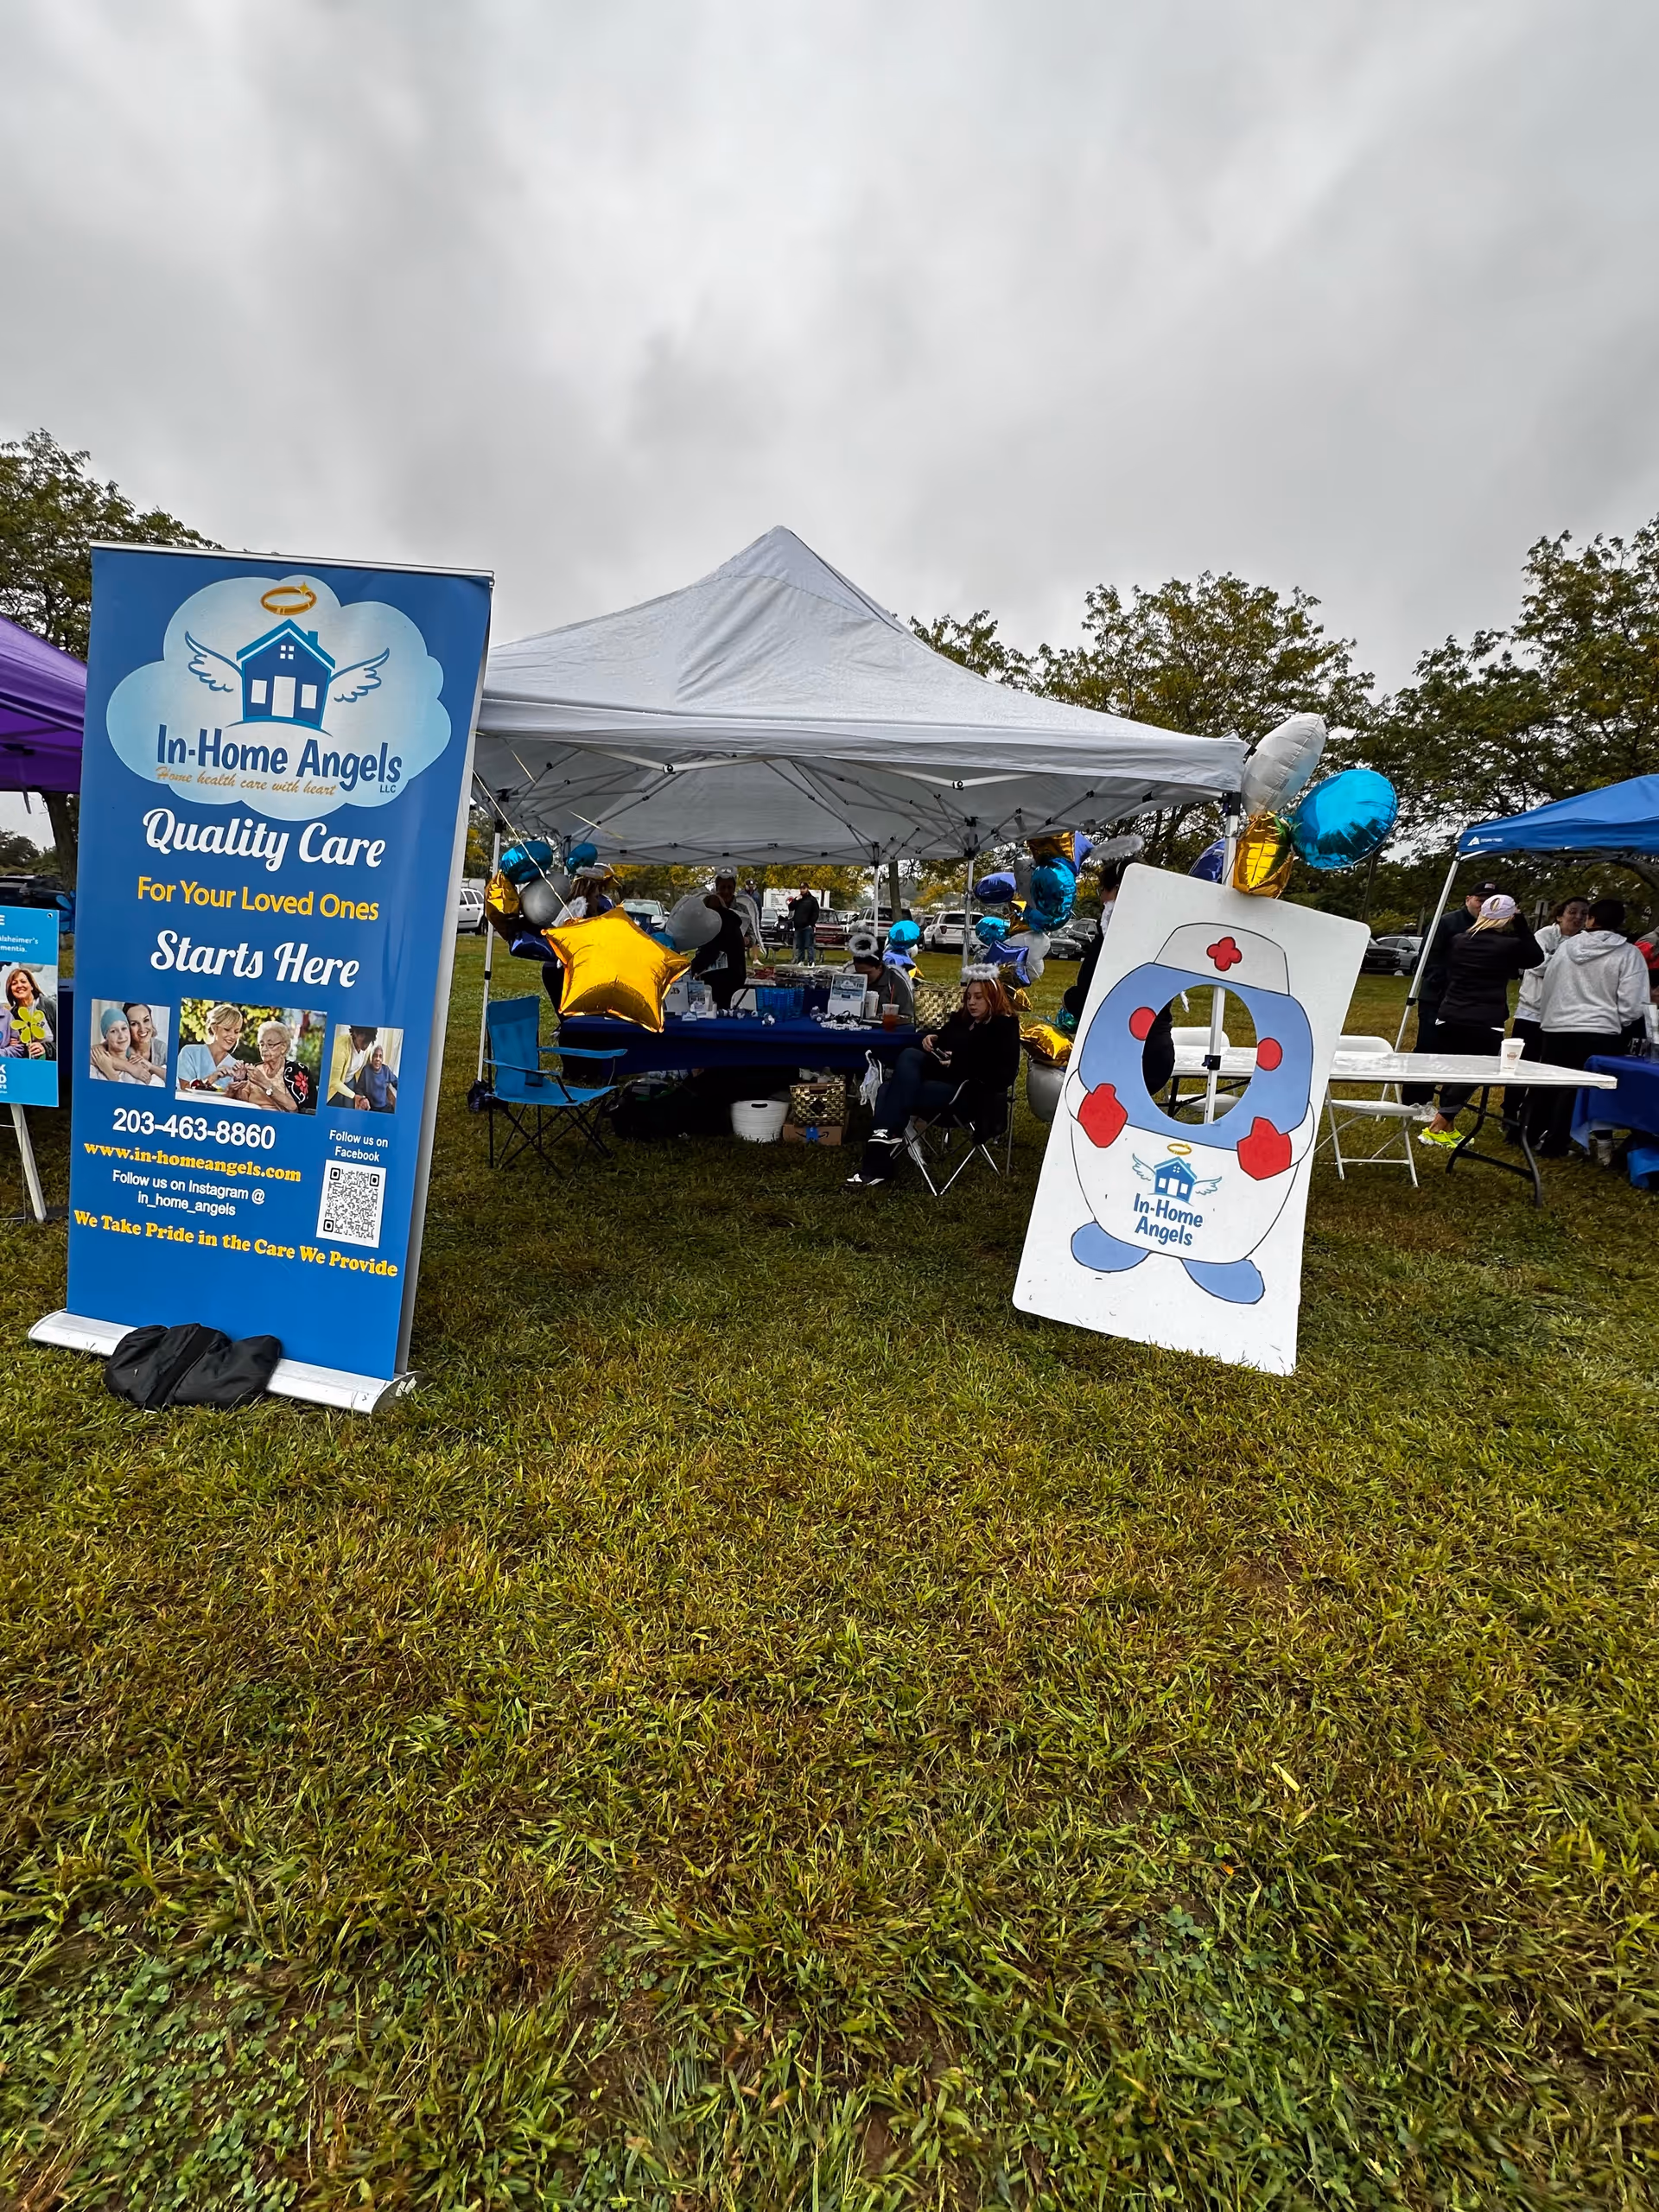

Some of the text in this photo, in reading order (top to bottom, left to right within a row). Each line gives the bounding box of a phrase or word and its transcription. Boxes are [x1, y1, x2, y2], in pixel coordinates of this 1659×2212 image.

[157, 723, 402, 791] In-Home Angels
[156, 766, 336, 796] Home health care with heart
[379, 785, 397, 793] LLC
[143, 808, 385, 872] Quality Care
[137, 876, 379, 921] For Your Loved Ones
[0, 935, 39, 944] lzheimer's
[150, 930, 359, 988] Starts Here
[112, 1108, 276, 1150] 203-463-8860
[328, 1129, 389, 1148] Follow us on
[84, 1143, 302, 1182] www.in-homeangels.com
[334, 1146, 380, 1162] Facebook
[112, 1169, 265, 1205] Follow us on Instagram @
[137, 1191, 237, 1217] in_home_angels
[1133, 1192, 1204, 1228] In-Home
[73, 1210, 398, 1277] We Take Pride in the Care We Provide
[1135, 1215, 1193, 1246] Angels
